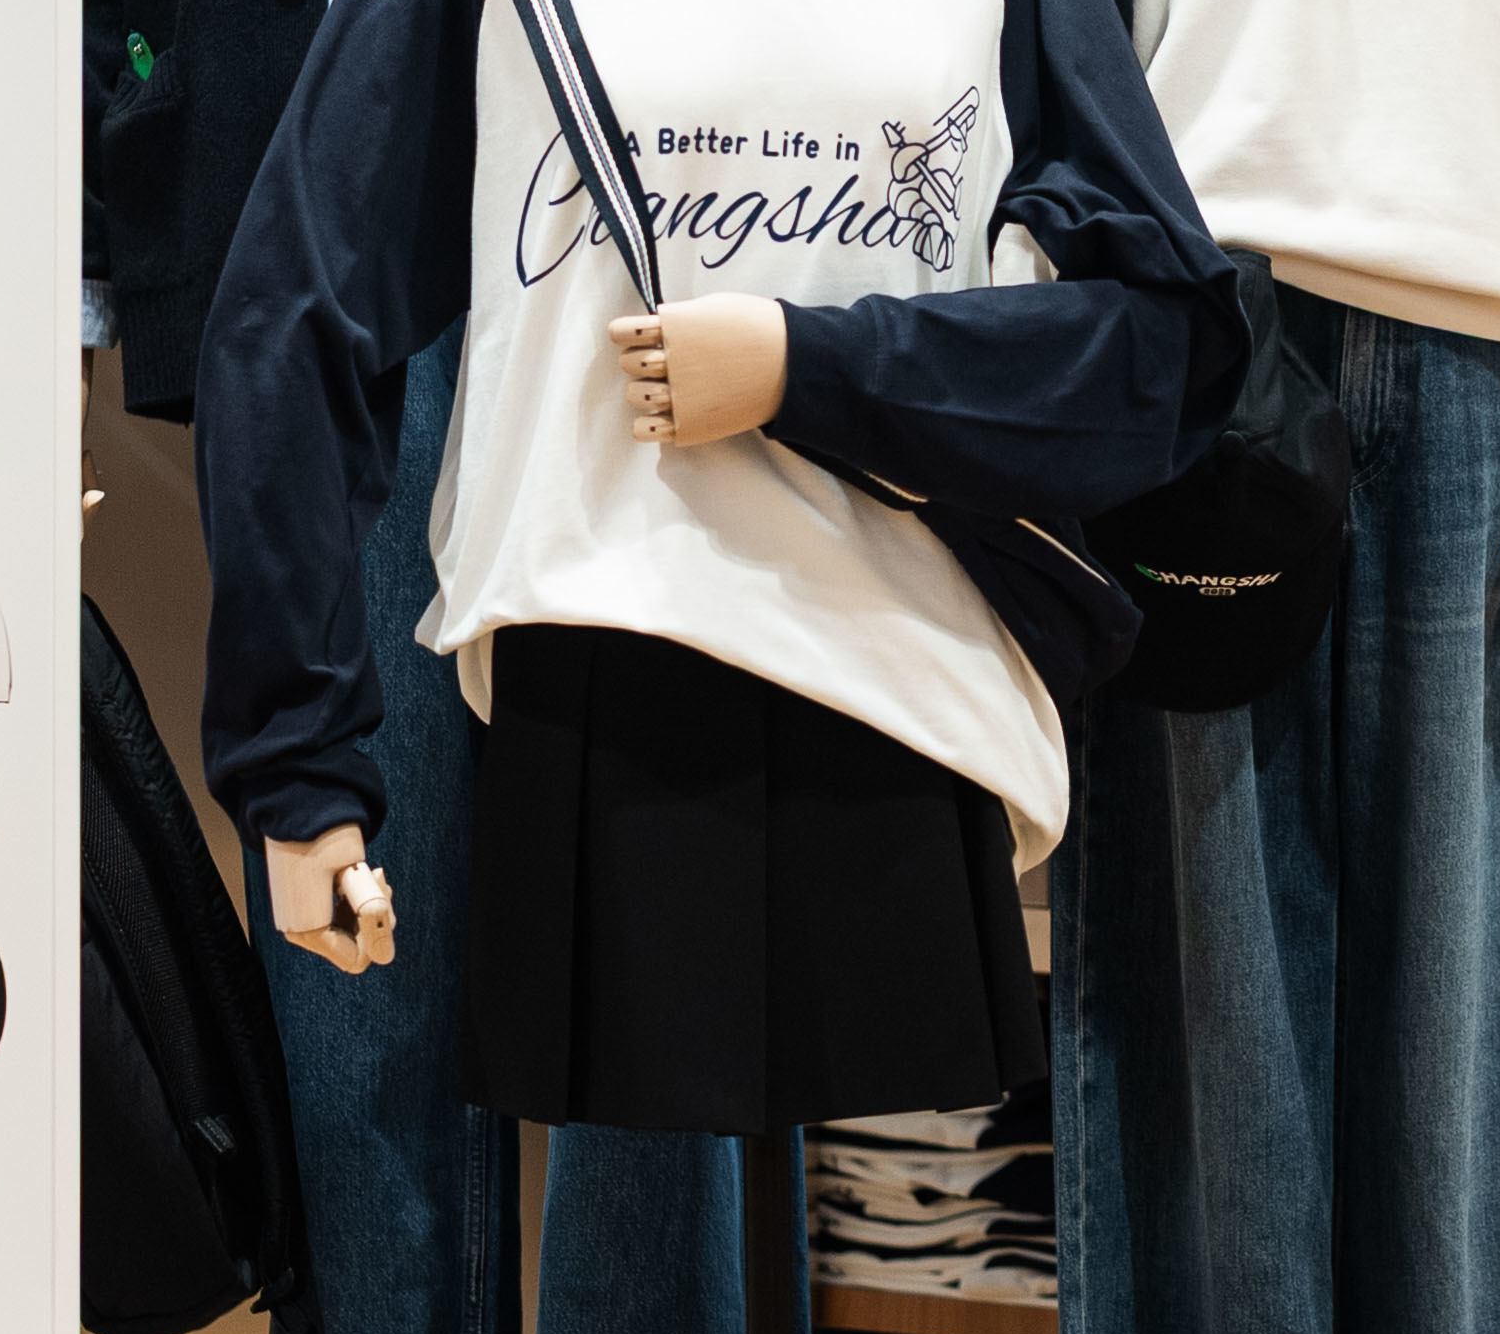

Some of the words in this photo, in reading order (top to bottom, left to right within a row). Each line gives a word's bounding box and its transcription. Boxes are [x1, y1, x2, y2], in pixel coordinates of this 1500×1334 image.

[657, 126, 749, 157] Better
[760, 129, 821, 160] Life
[835, 132, 861, 162] in
[1135, 563, 1283, 588] CHANGSHA
